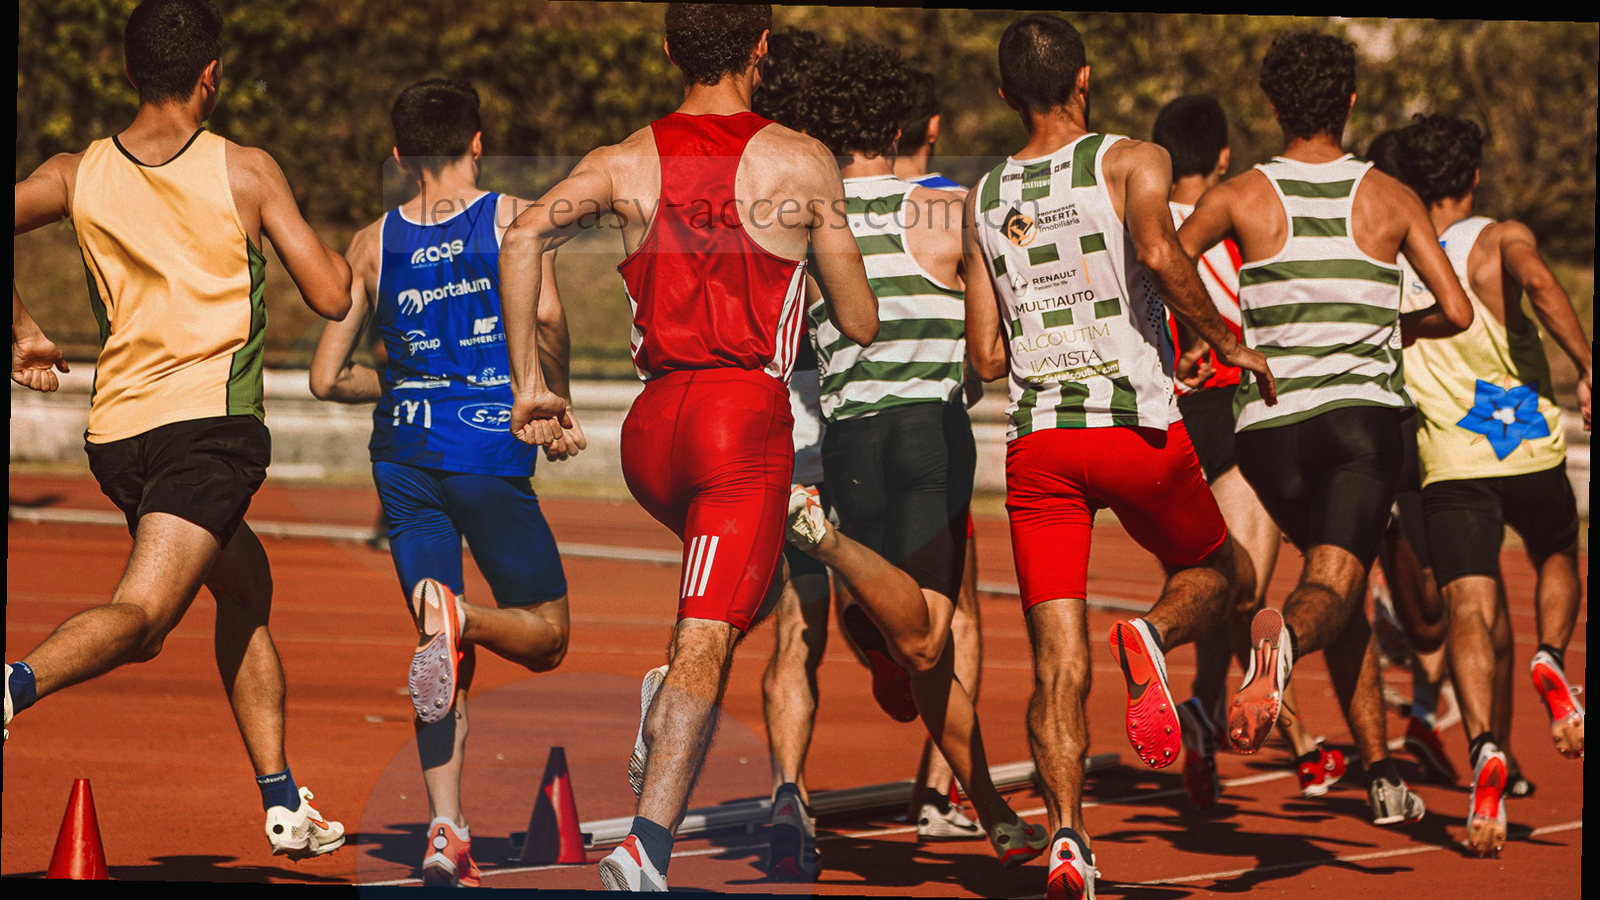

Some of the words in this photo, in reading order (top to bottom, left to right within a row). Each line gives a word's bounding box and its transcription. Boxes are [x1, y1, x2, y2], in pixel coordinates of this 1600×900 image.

[1037, 209, 1079, 226] ABERTA
[1032, 269, 1077, 286] RENAULT
[422, 277, 492, 306] portalum
[1014, 289, 1095, 316] MULTIAUTO
[409, 338, 441, 357] group
[1016, 323, 1110, 356] ALCOUTIM
[1030, 349, 1105, 374] INVISTA
